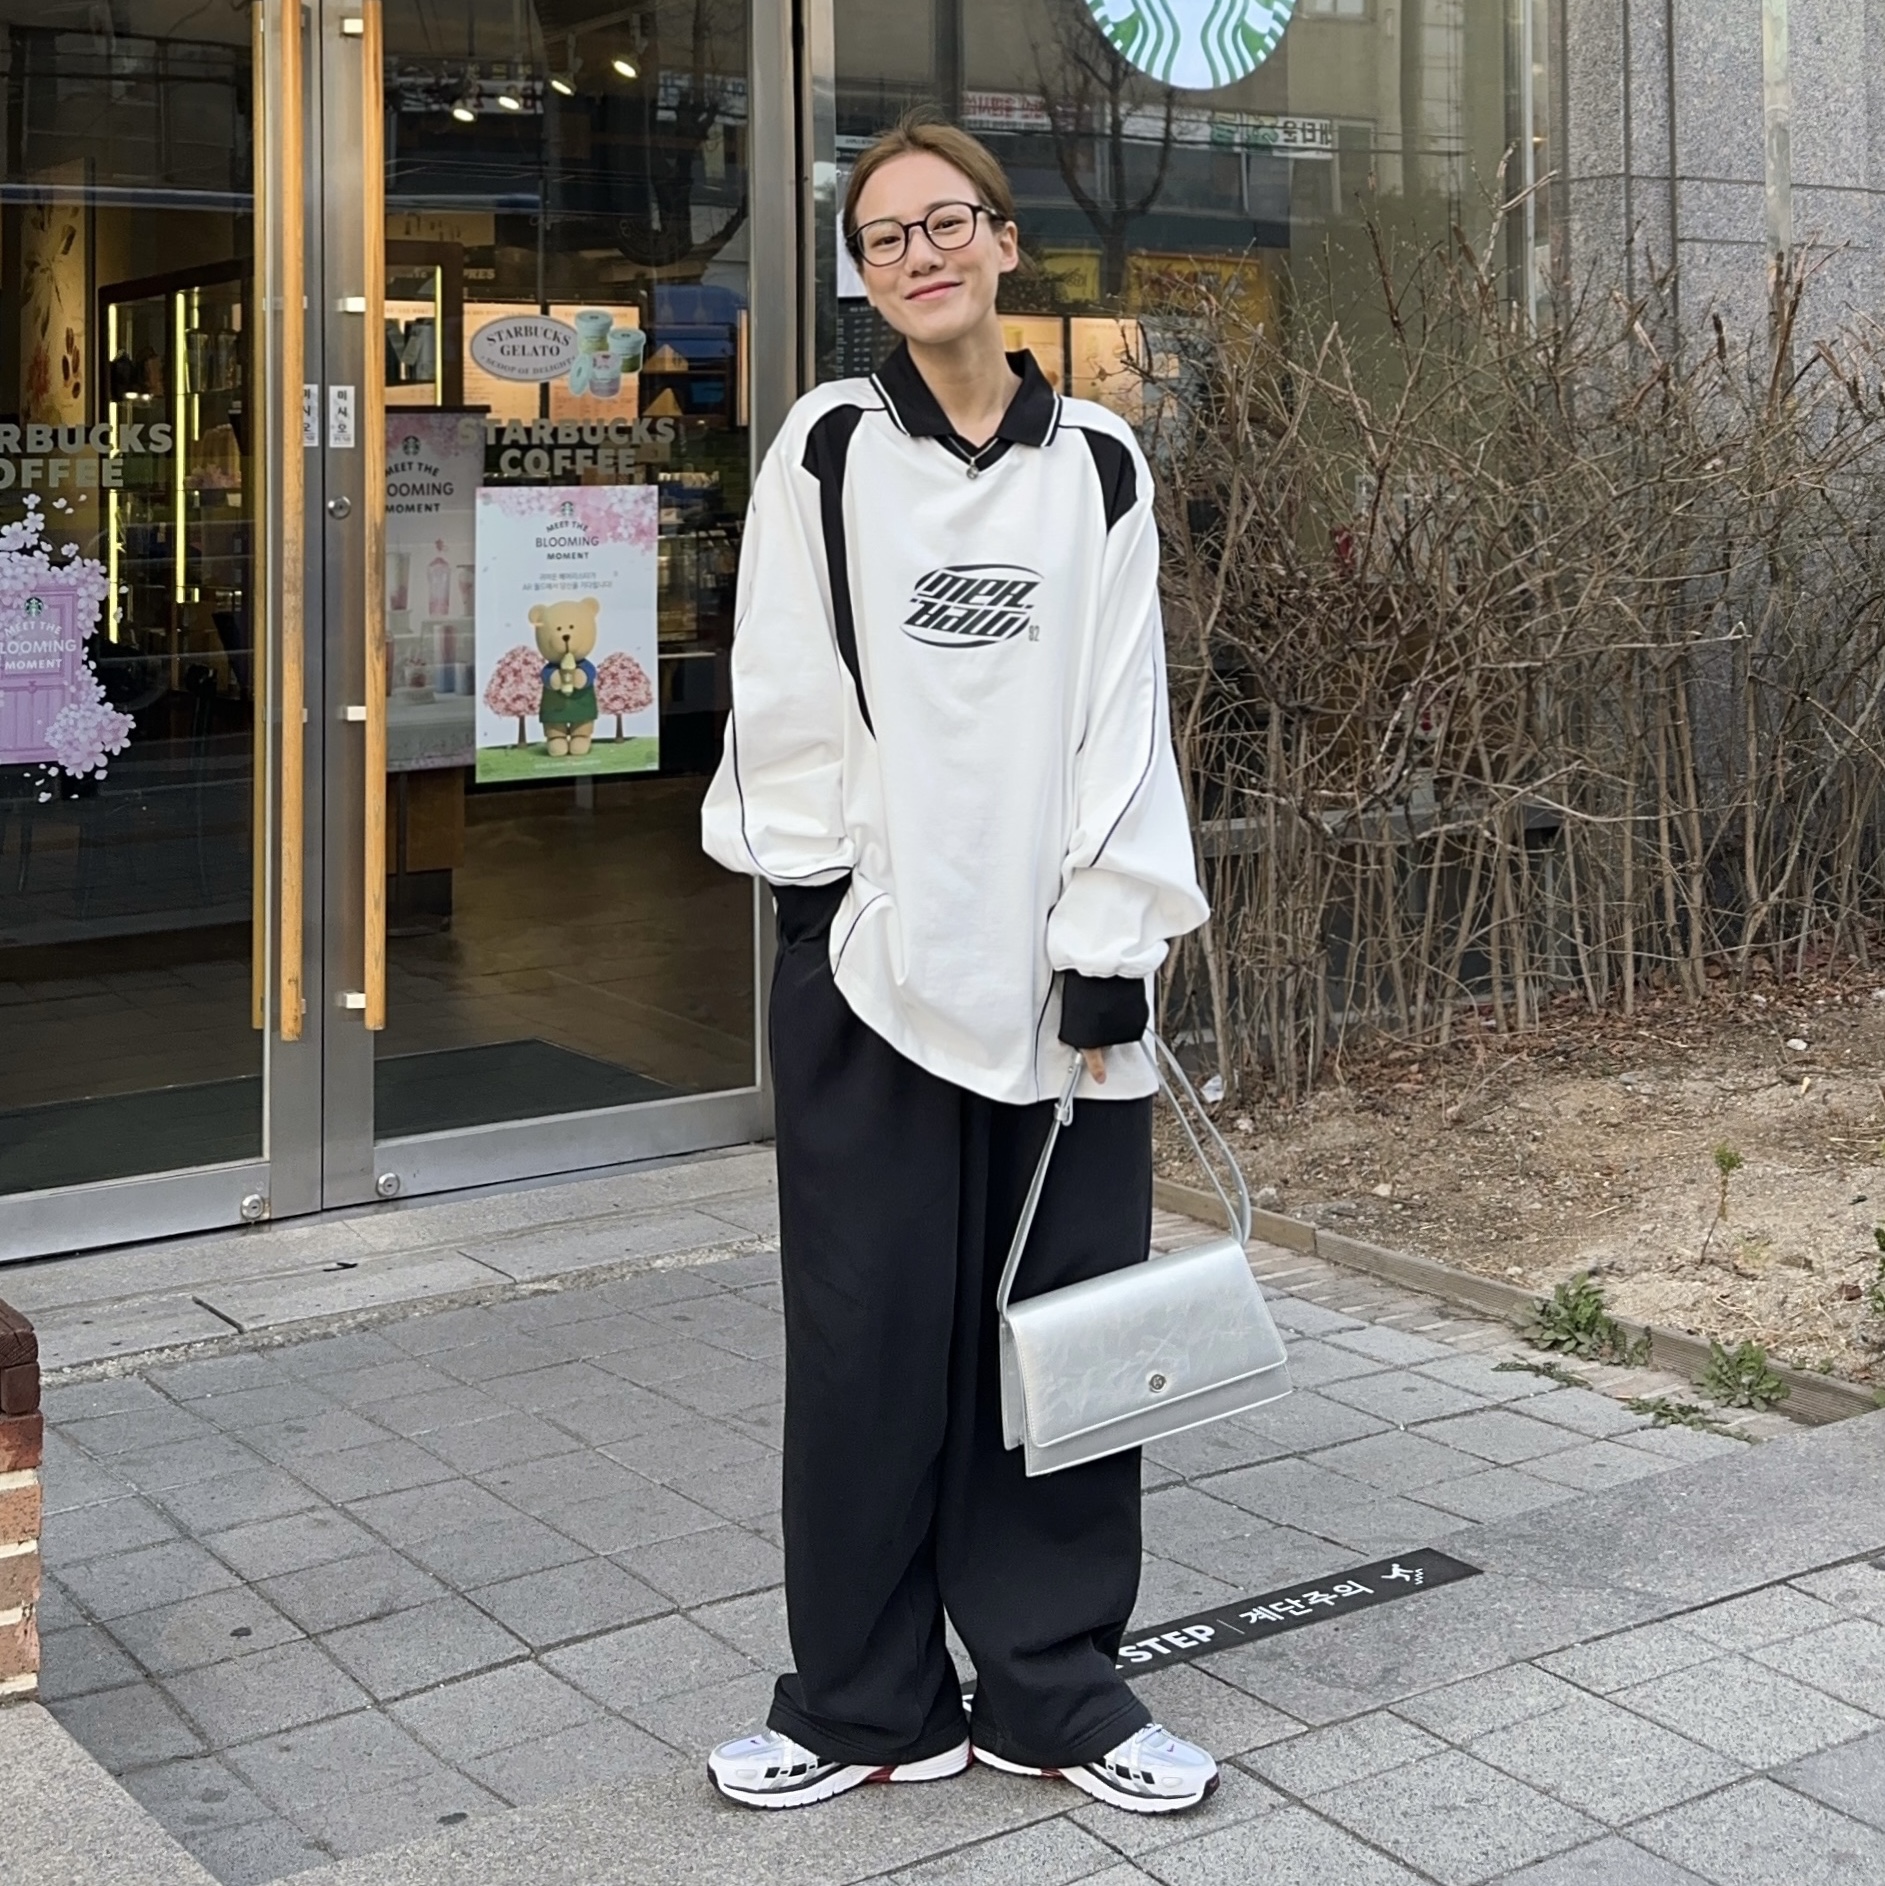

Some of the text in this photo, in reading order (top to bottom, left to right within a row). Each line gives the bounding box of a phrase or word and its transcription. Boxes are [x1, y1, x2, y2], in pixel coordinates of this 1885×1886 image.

[486, 325, 572, 346] STARBUCKS
[500, 344, 560, 357] GELATO
[486, 358, 516, 374] SCOOP
[532, 359, 572, 374] DELIGHT
[337, 389, 347, 434] 미시오
[0, 422, 172, 454] RBUCKS
[458, 417, 676, 446] STARBUCKS
[386, 462, 440, 477] MEET THE
[500, 448, 636, 476] COFFEE
[0, 458, 124, 490] OFFEE
[386, 482, 454, 497] OOMING
[386, 503, 440, 514] MOMENT
[546, 520, 588, 532] MEET THE
[536, 536, 600, 548] BLOOMING
[546, 552, 589, 560] MOMENT
[4, 621, 62, 637] MEET THE
[0, 639, 77, 655] LOOMING
[5, 658, 62, 670] MOMENT
[1239, 1580, 1374, 1624] 계단주의
[1118, 1624, 1216, 1663] STEP
